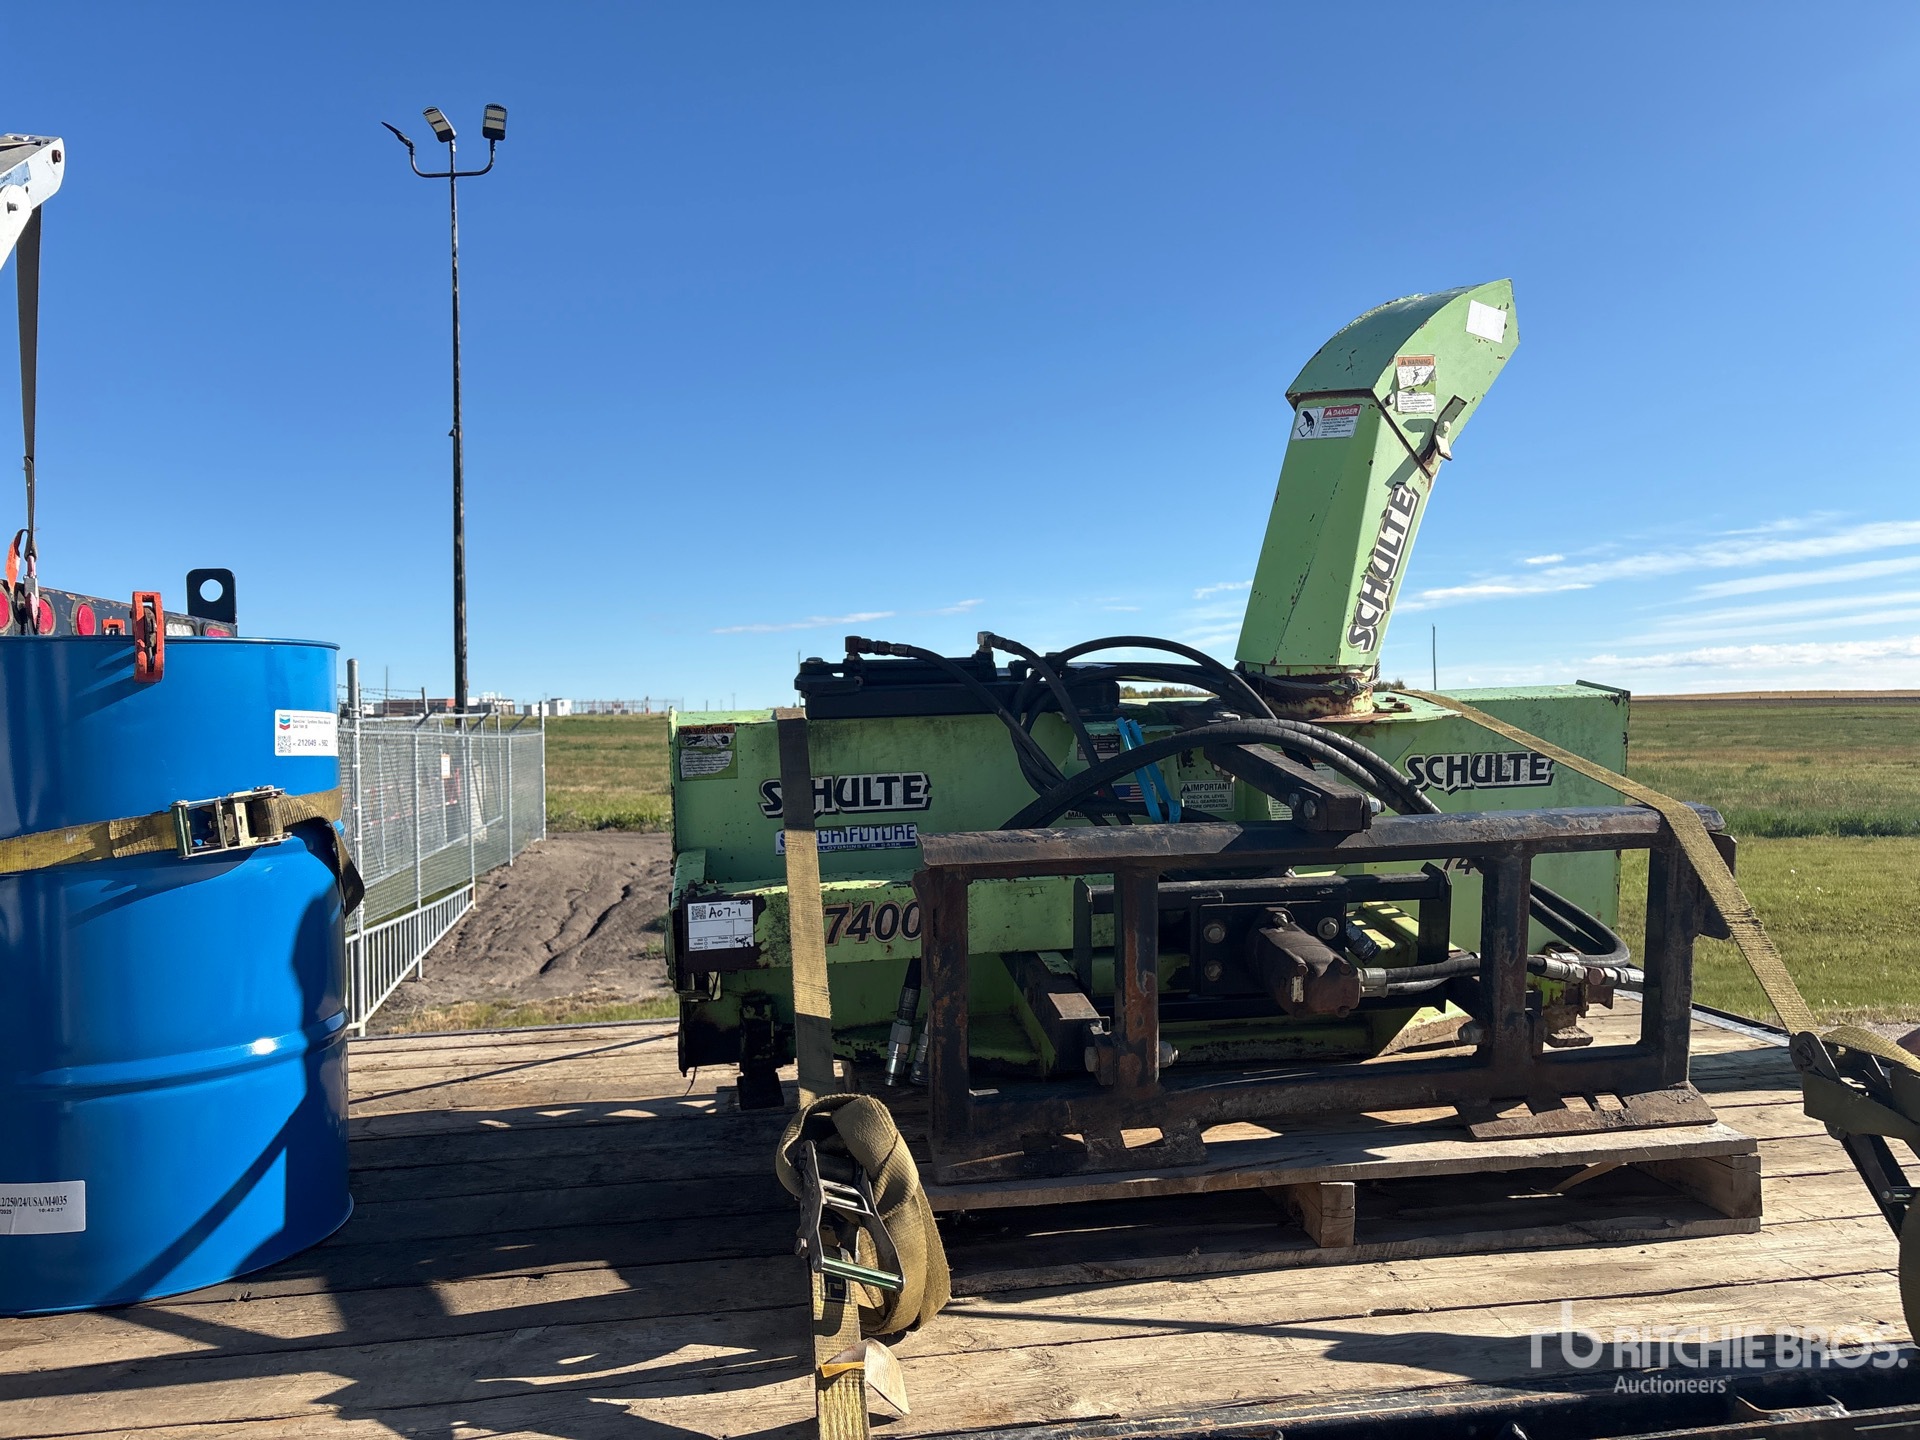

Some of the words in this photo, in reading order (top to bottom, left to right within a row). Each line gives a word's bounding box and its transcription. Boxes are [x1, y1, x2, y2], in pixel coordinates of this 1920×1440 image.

[1332, 408, 1358, 416] DANGER
[1348, 482, 1421, 653] SCHULTE
[1190, 783, 1231, 791] IMPORTANT
[1404, 752, 1555, 793] SCHULTE
[759, 774, 932, 817] SHULTE
[817, 824, 916, 844] GRIFUTURE
[823, 900, 922, 945] 7400
